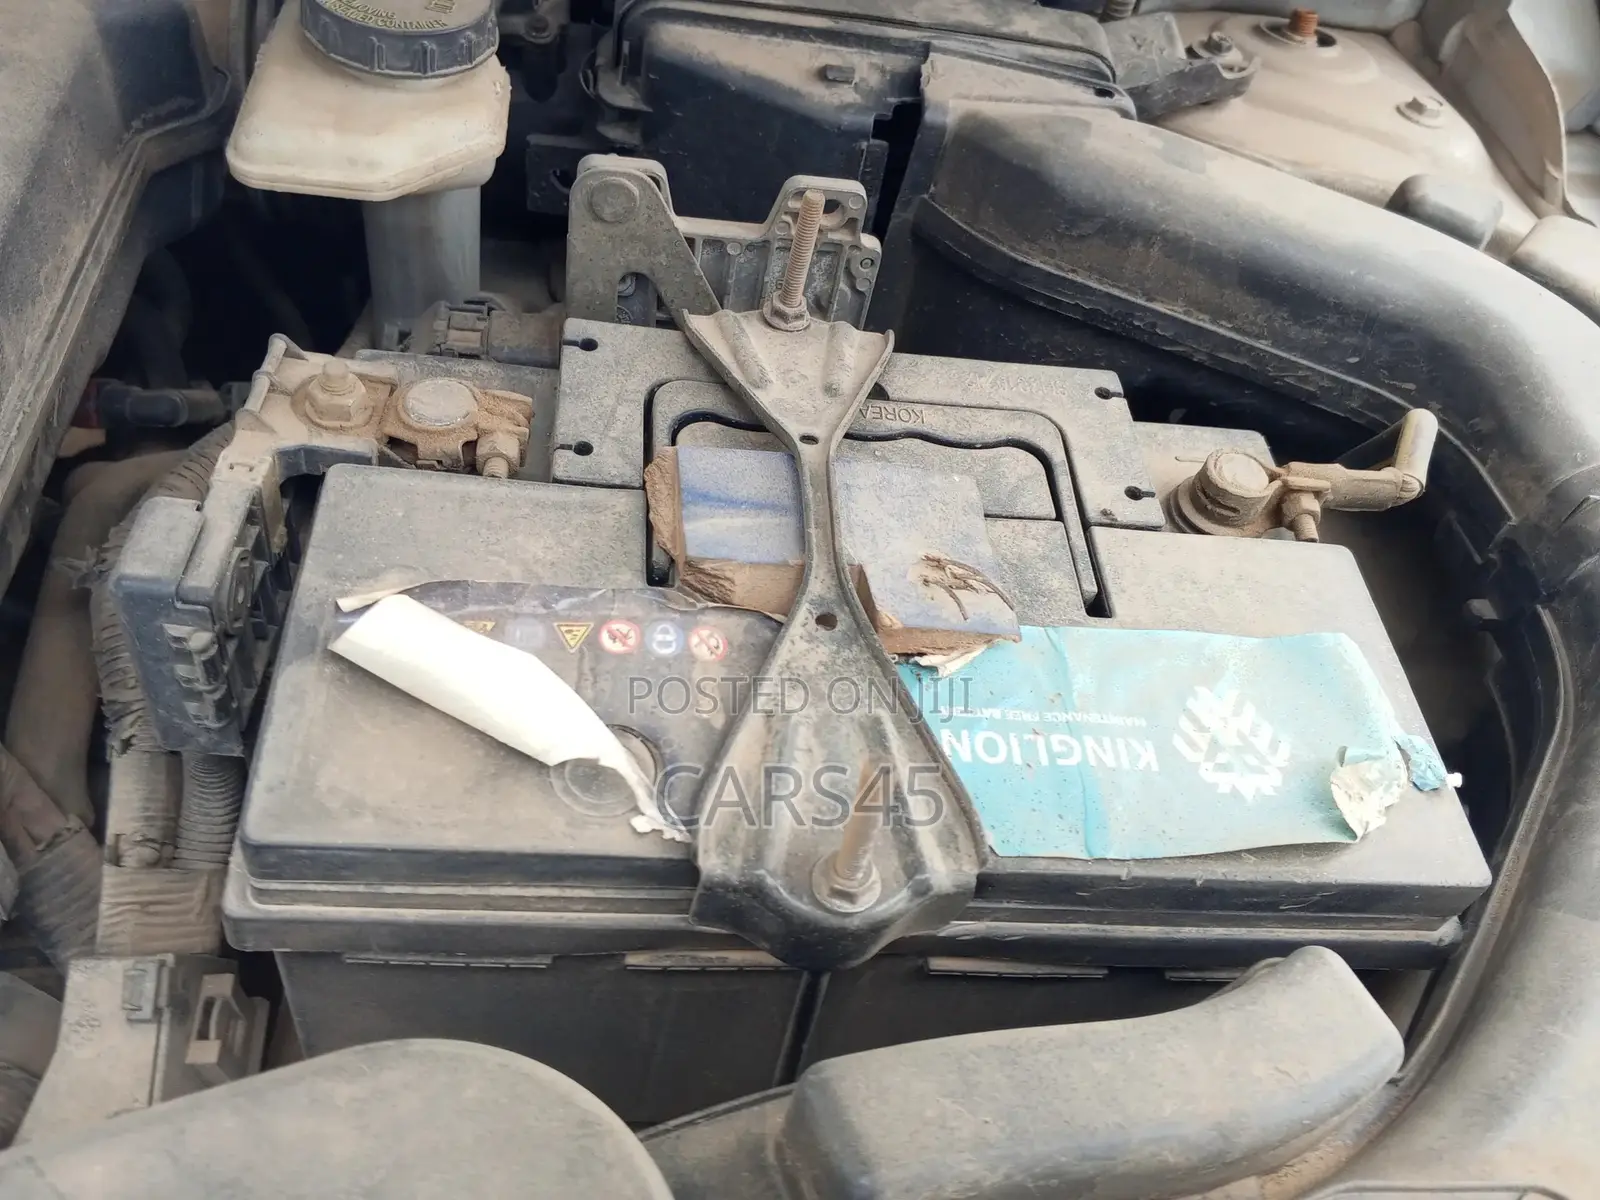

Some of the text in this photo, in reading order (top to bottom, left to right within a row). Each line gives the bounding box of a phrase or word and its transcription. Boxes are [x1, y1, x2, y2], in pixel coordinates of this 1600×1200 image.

[858, 404, 925, 424] KOREA
[1004, 709, 1041, 723] FREE
[1043, 711, 1147, 728] MAINTENANCE
[940, 728, 1160, 772] KINGLION
